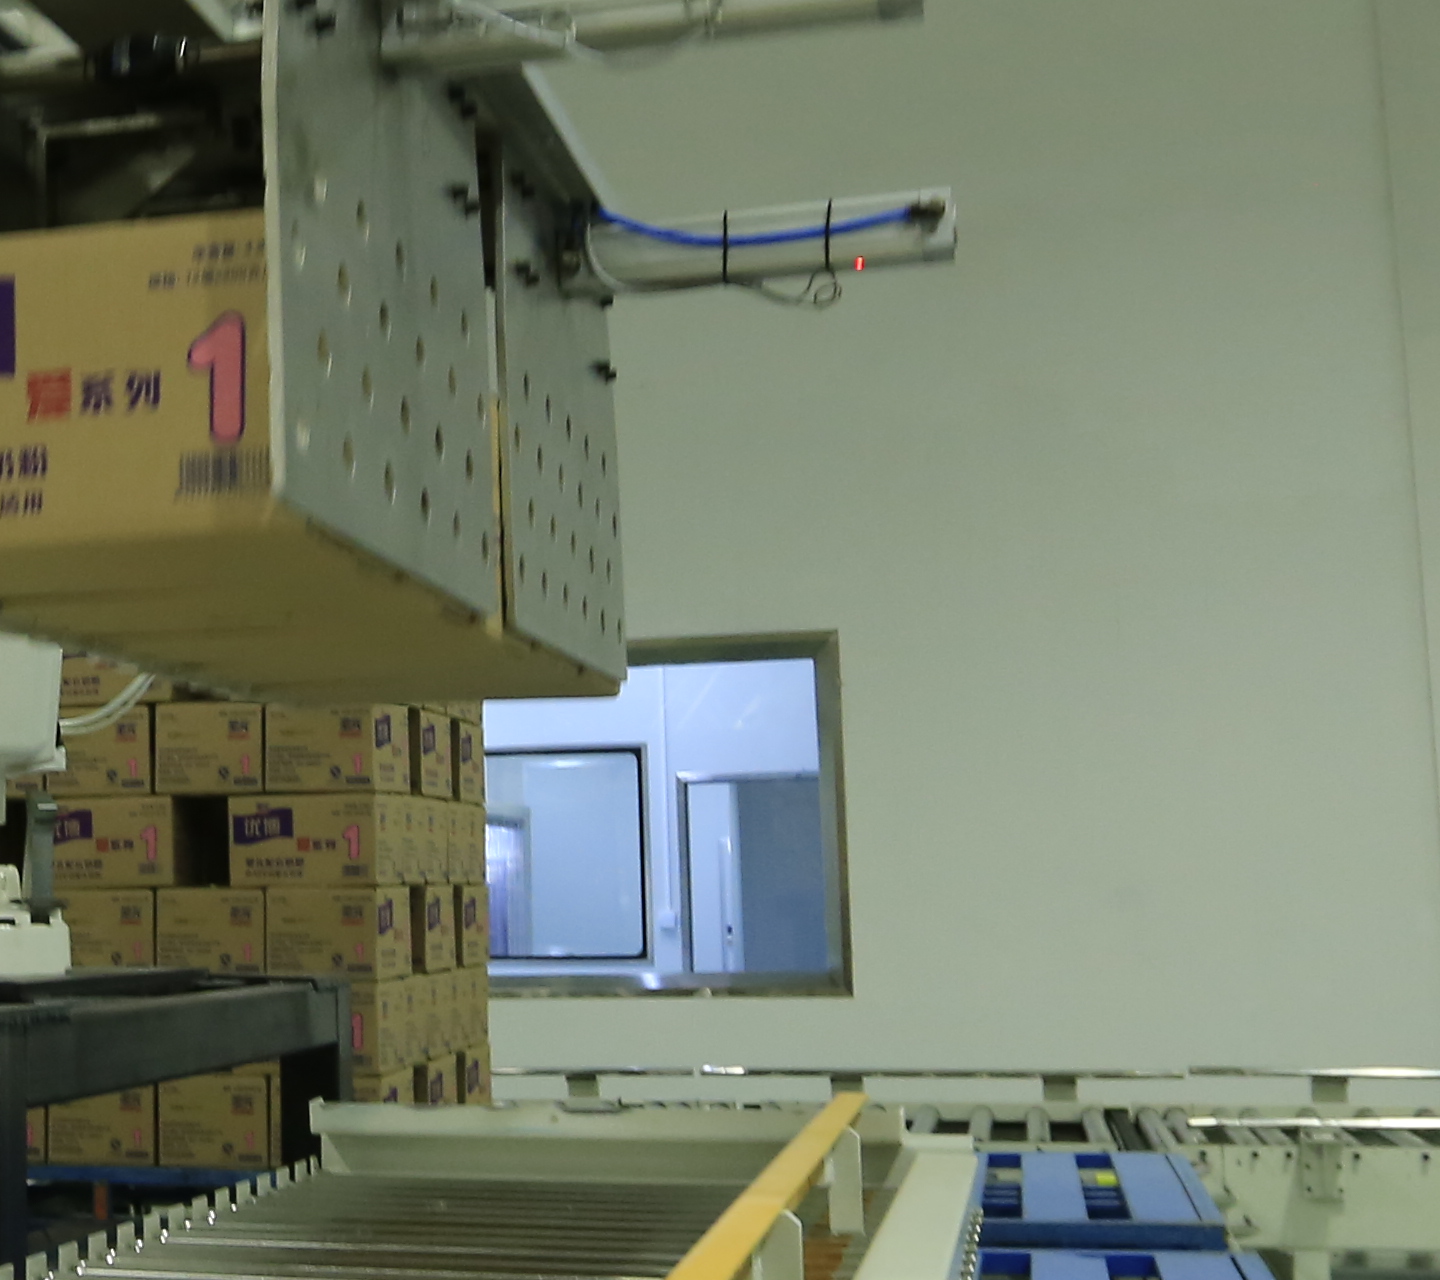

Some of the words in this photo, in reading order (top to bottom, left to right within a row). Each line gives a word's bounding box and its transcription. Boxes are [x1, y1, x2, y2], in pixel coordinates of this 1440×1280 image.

[186, 308, 246, 444] 1
[140, 825, 158, 862] 1
[342, 824, 360, 859] 1
